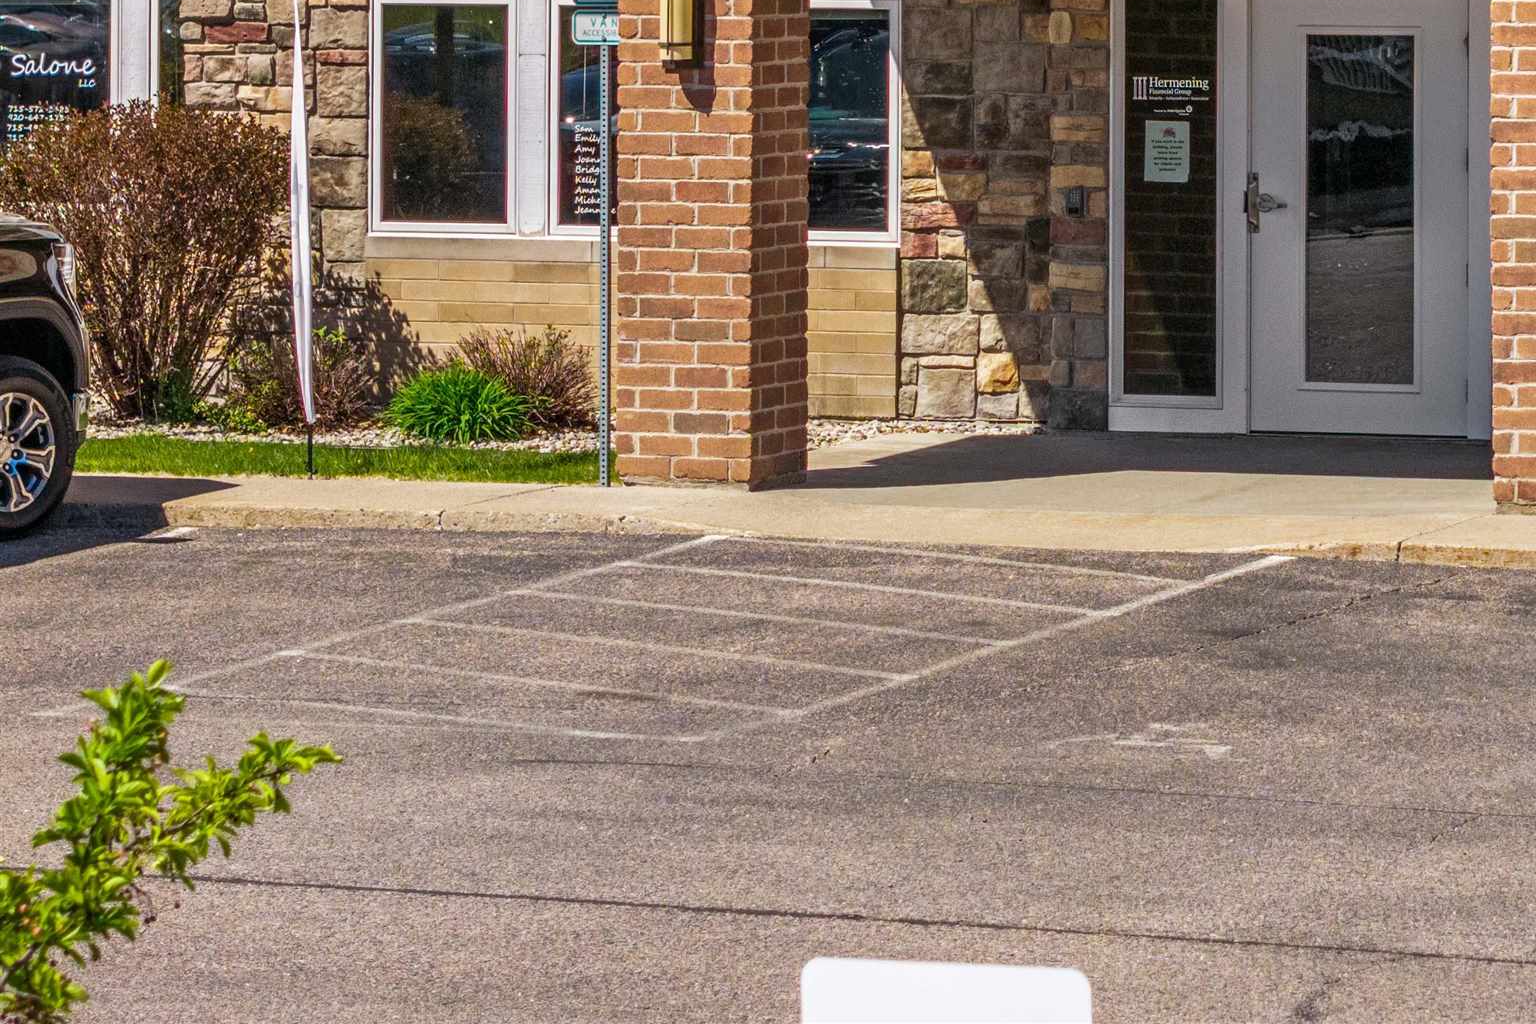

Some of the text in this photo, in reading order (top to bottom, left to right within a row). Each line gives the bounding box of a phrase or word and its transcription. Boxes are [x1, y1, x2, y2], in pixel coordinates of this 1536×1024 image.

[10, 52, 97, 76] Salone
[78, 79, 96, 88] LLC
[1148, 75, 1210, 91] Hermening
[574, 145, 596, 155] Amy
[575, 165, 600, 175] Bridg
[575, 176, 597, 186] Kelly
[574, 187, 600, 195] Aman
